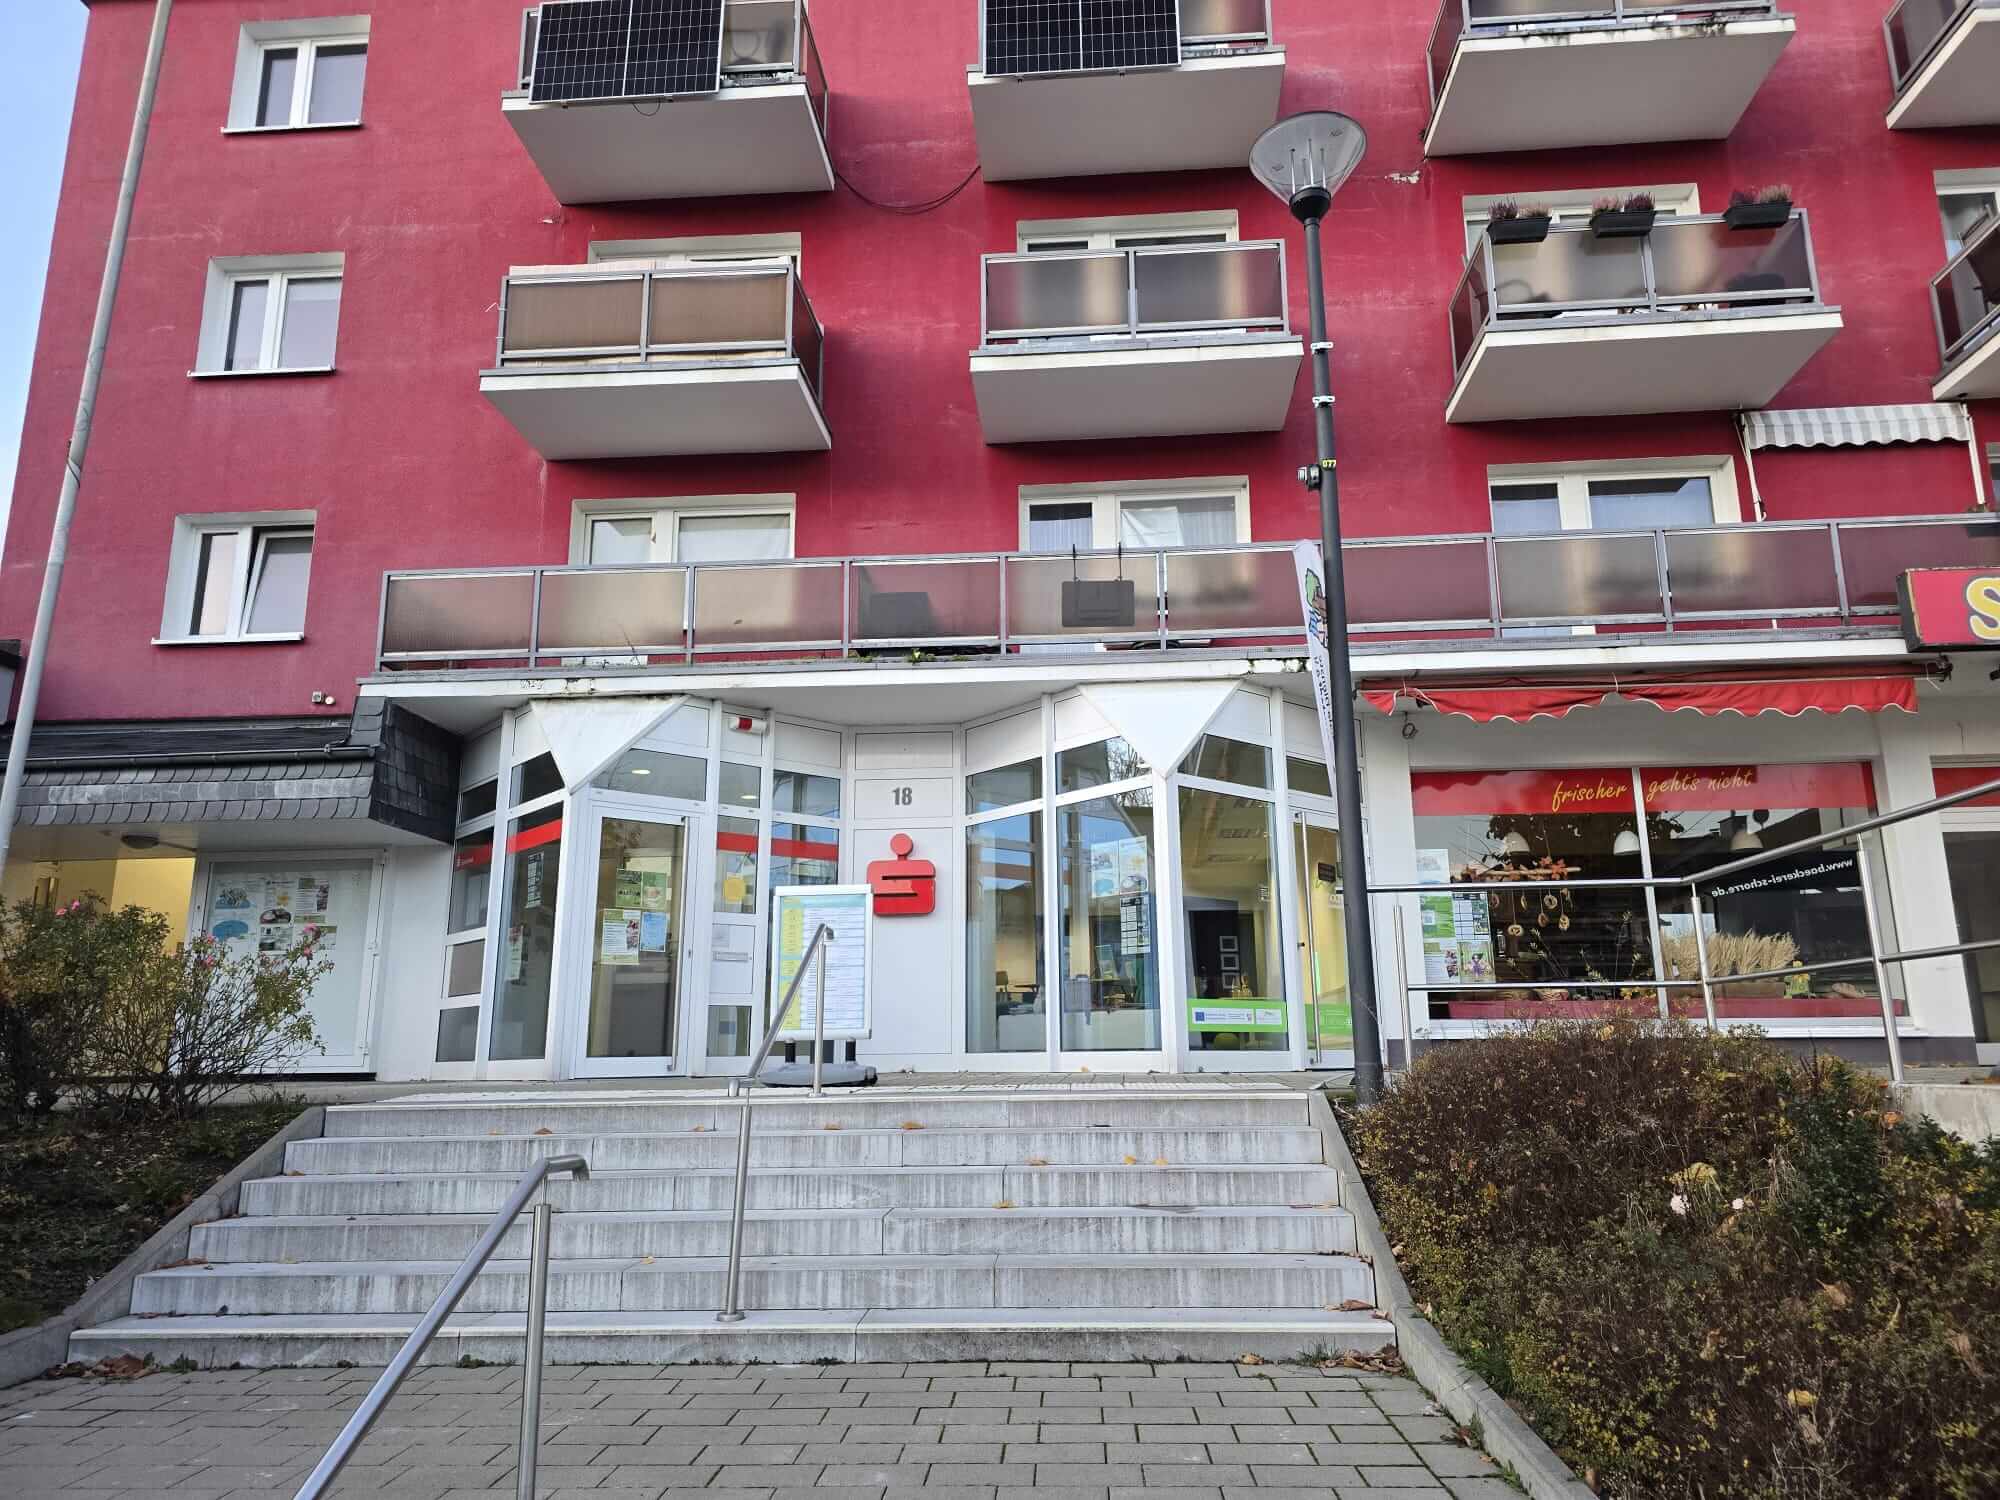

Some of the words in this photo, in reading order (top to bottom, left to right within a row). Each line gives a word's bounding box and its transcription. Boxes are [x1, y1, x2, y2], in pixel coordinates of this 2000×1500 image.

[892, 787, 912, 806] 18
[1552, 778, 1627, 812] frischer
[1707, 767, 1754, 791] nicht
